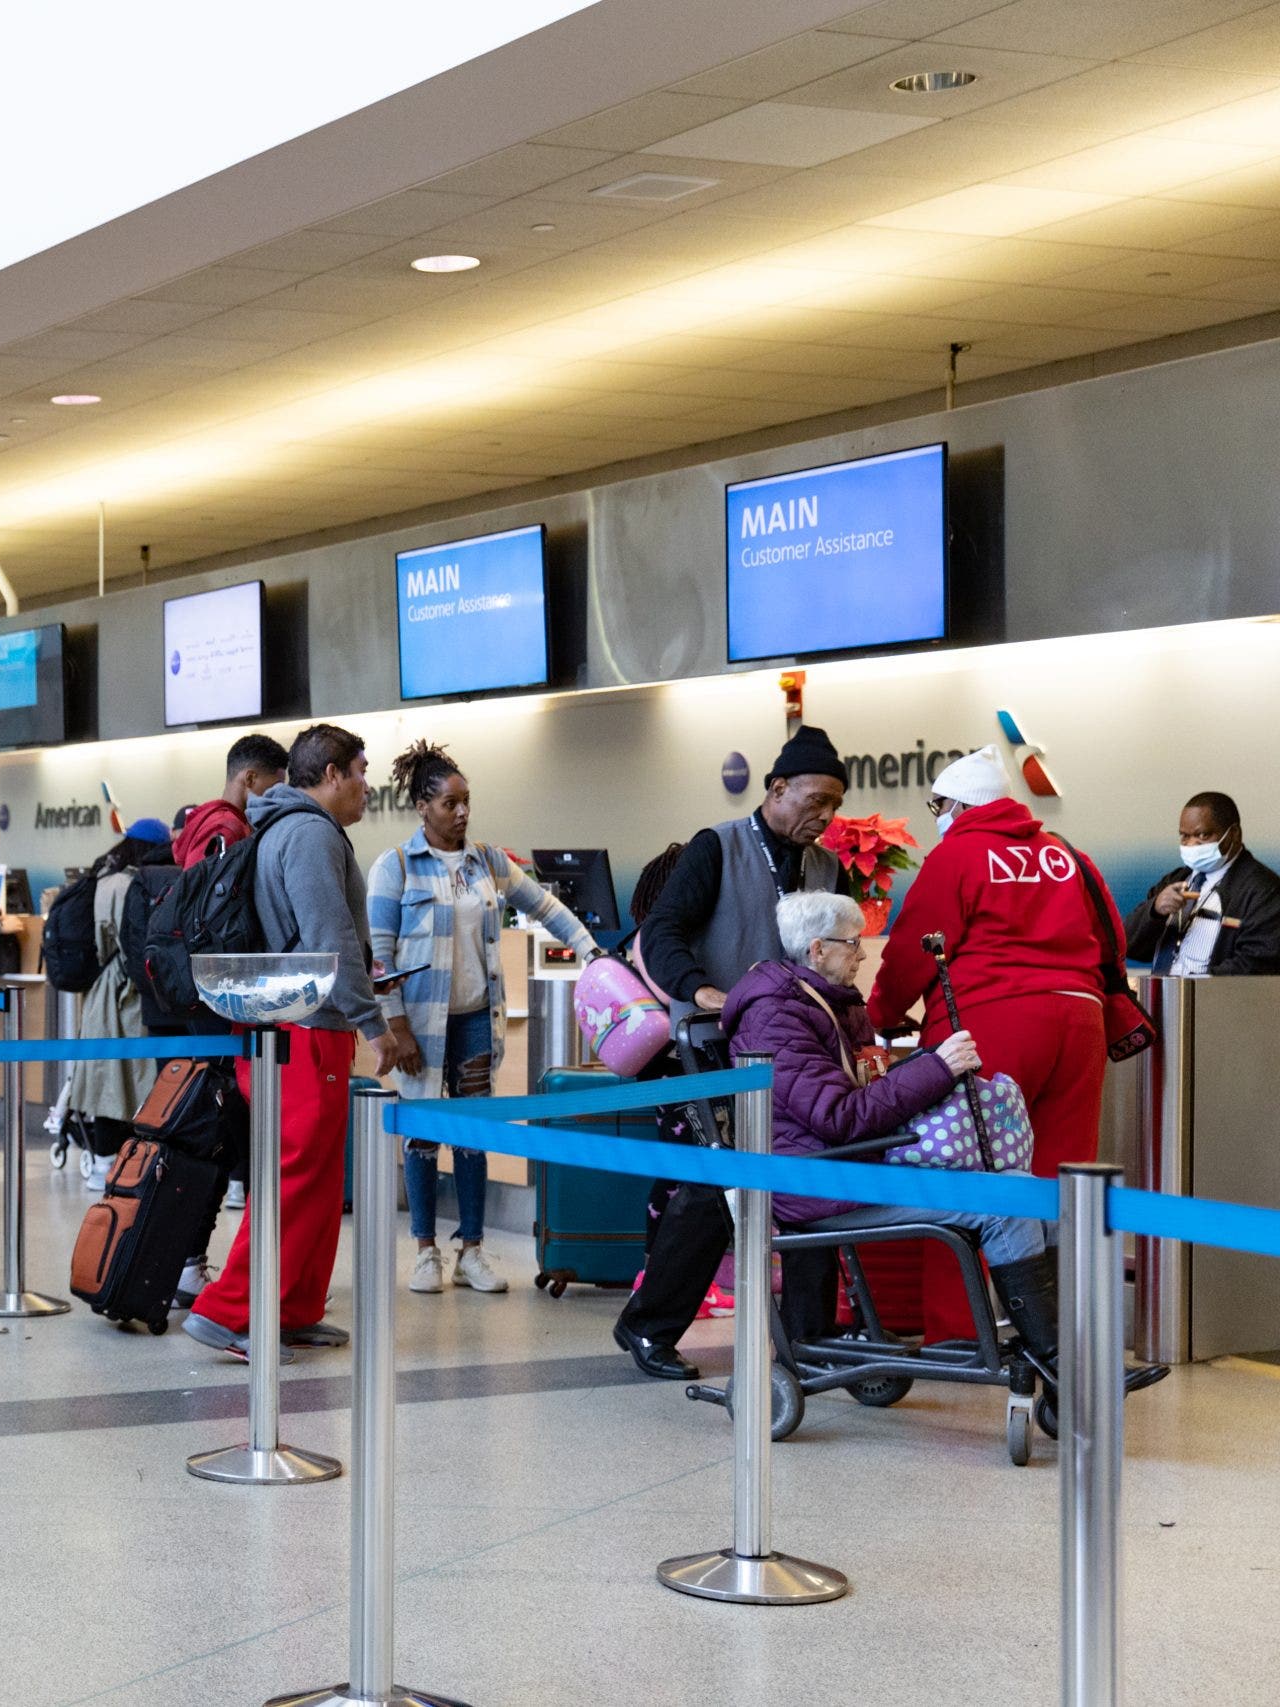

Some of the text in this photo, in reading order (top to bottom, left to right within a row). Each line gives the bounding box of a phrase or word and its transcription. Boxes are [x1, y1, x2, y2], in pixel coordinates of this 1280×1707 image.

[741, 495, 819, 538] MAIN
[741, 529, 894, 568] Customer Assistance
[407, 563, 460, 598] MAIN
[408, 593, 512, 622] Customer Assistance
[844, 739, 983, 789] meric
[35, 799, 101, 829] American
